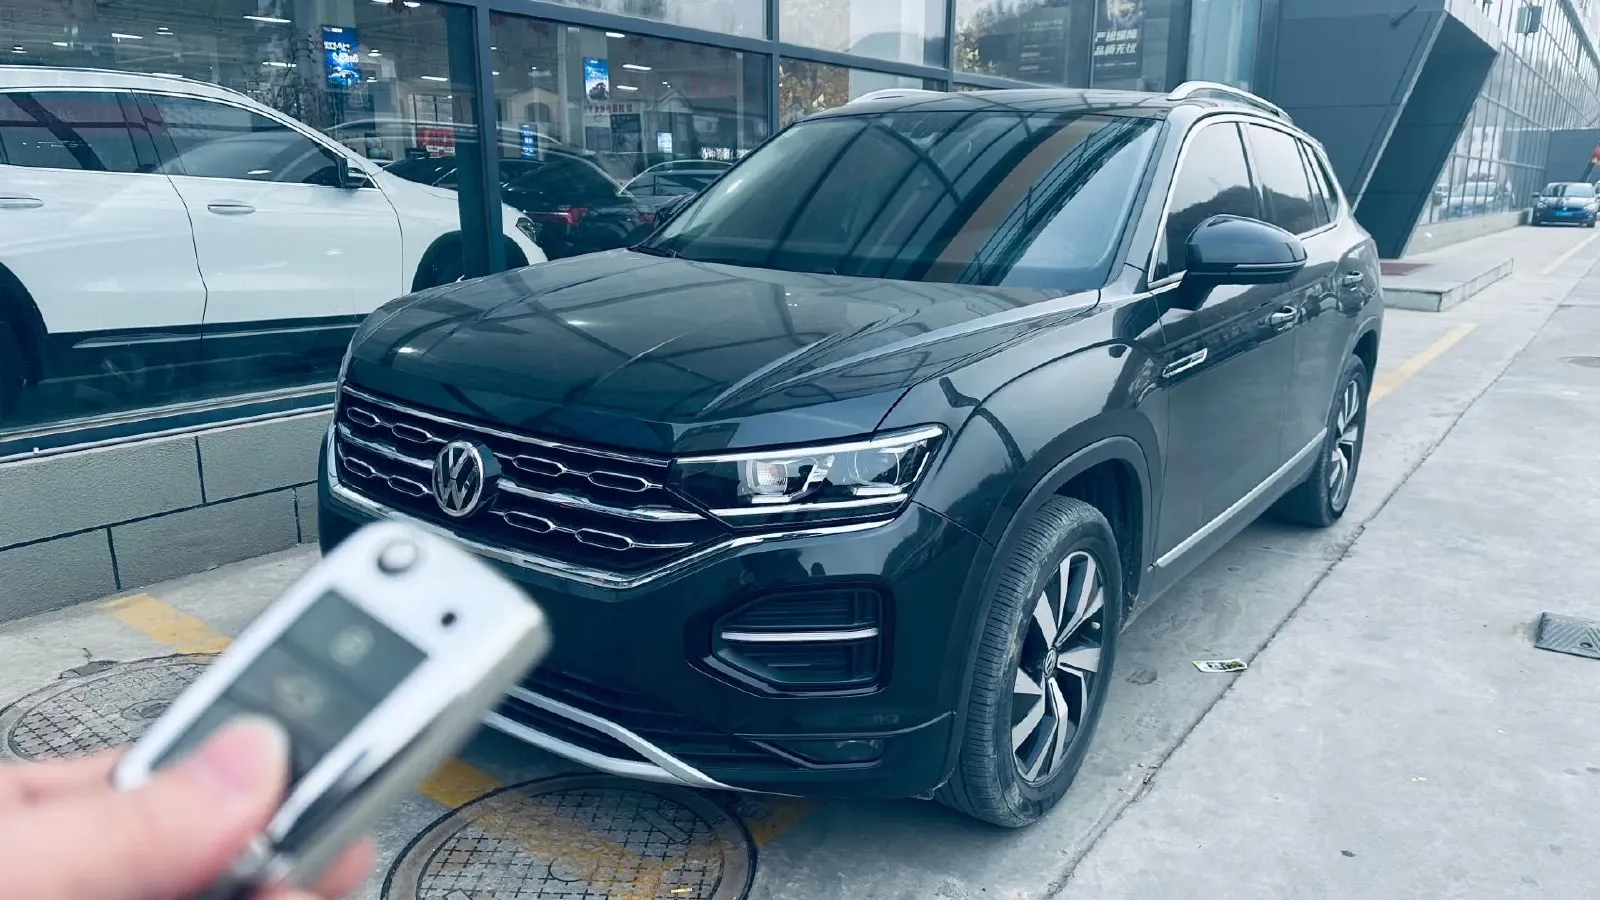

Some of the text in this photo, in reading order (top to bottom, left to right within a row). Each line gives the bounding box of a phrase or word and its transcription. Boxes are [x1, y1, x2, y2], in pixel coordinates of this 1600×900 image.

[1093, 43, 1138, 56] 品质无忧
[432, 441, 485, 517] VW
